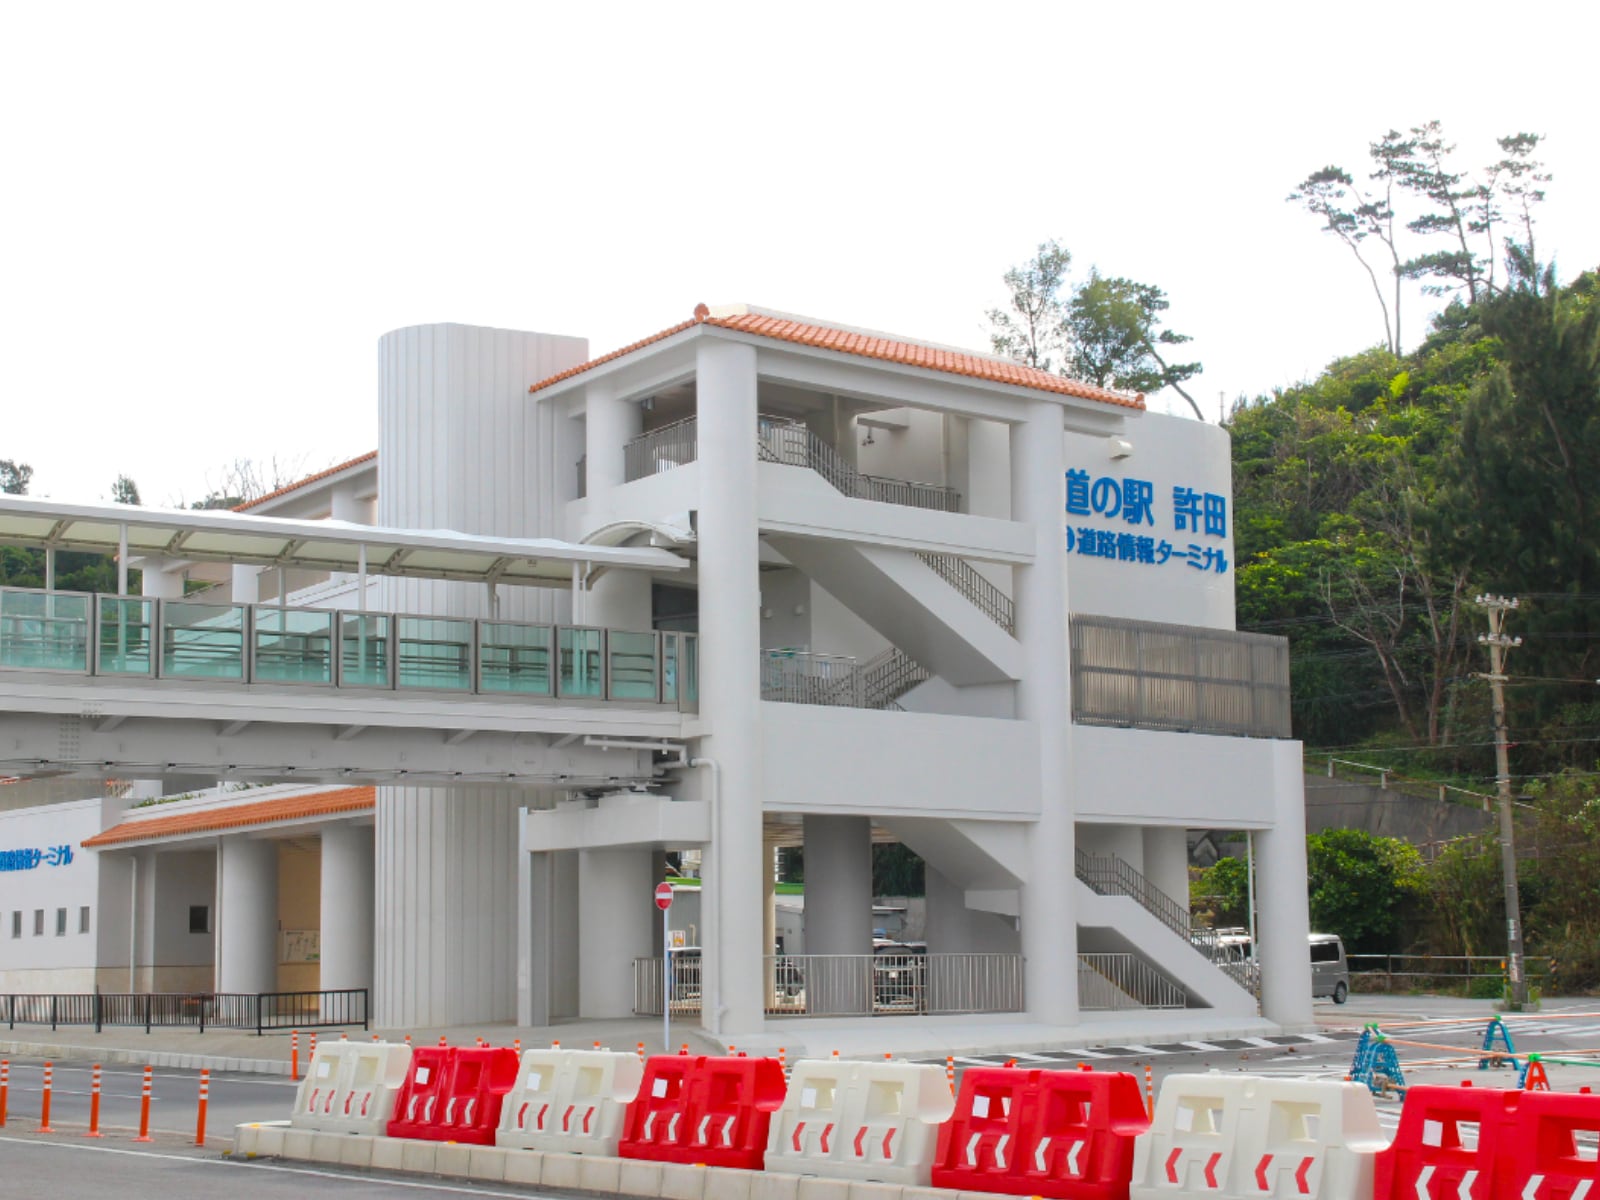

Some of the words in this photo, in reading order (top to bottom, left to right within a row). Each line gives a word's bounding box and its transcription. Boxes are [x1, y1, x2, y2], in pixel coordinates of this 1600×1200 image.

[1065, 468, 1154, 527] 道の駅
[1172, 486, 1227, 539] 許田
